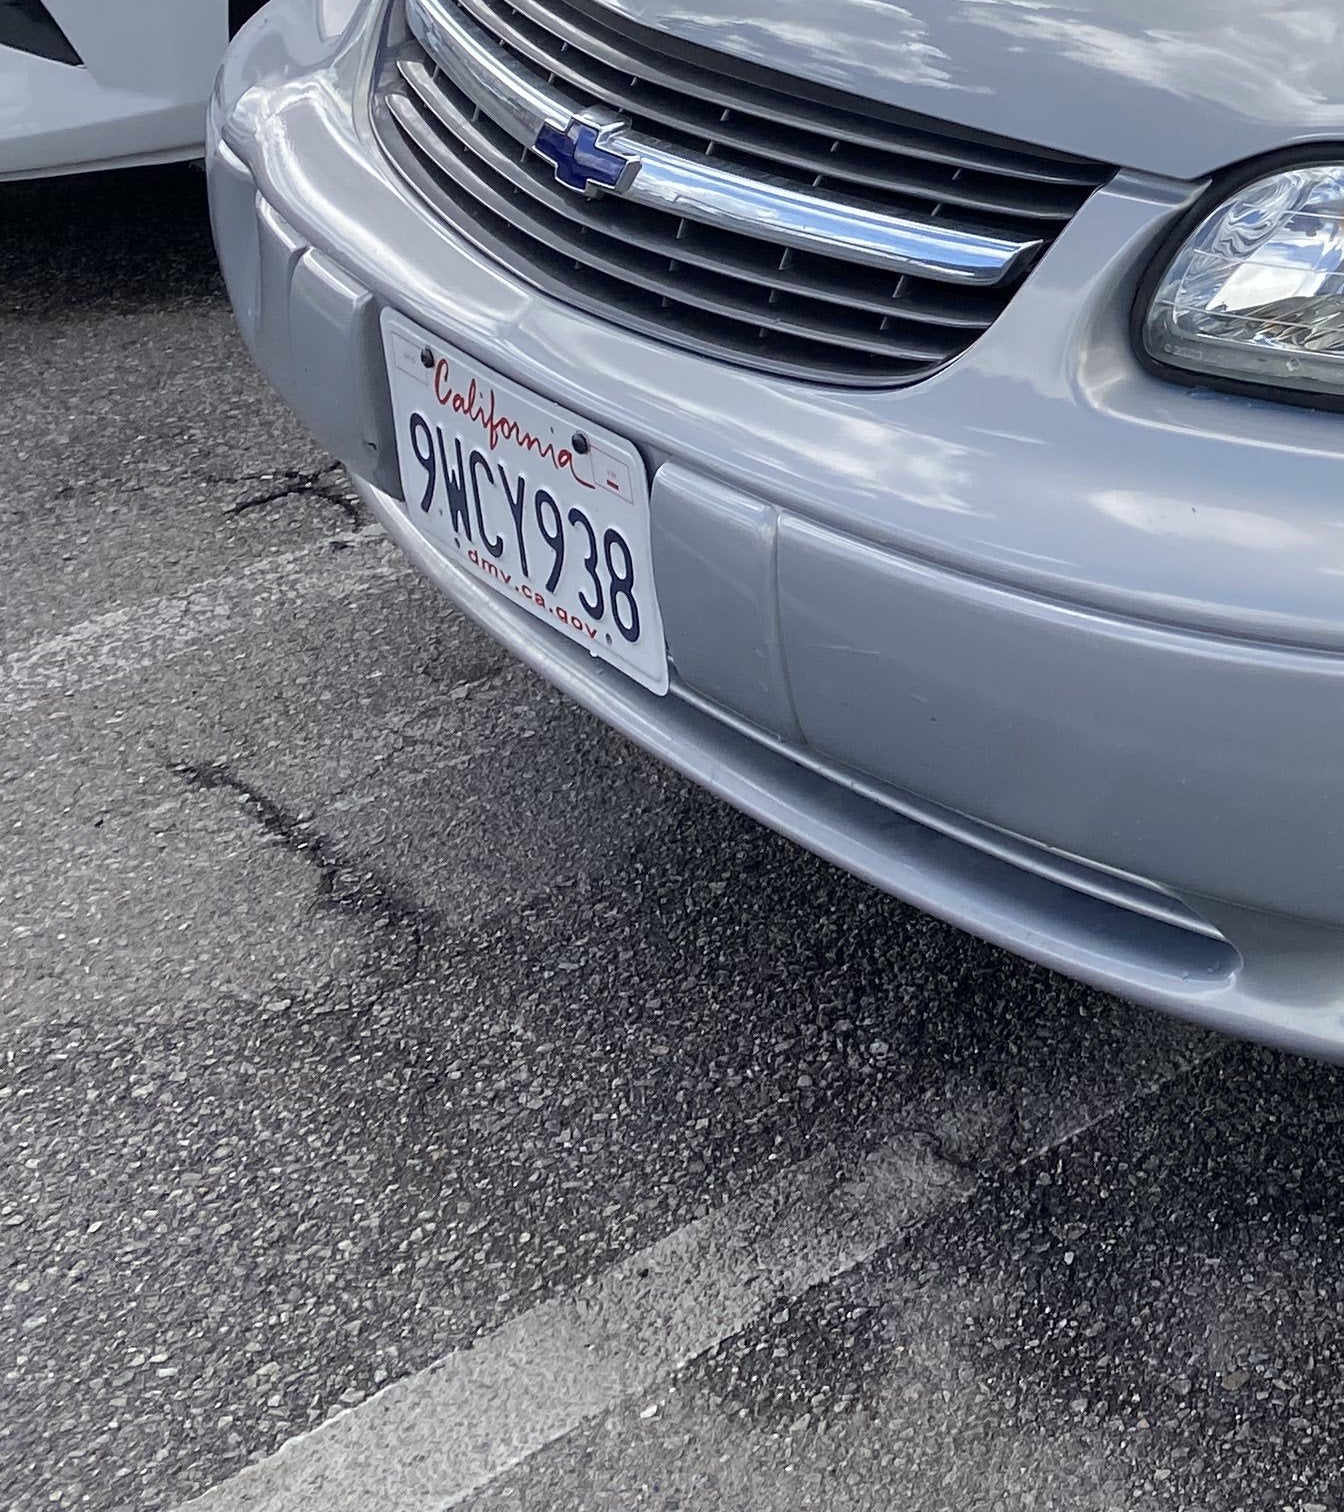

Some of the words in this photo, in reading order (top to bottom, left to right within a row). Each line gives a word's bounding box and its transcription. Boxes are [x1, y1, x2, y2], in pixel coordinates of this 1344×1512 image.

[435, 358, 596, 490] California
[409, 411, 641, 644] 9WCY938
[467, 548, 598, 640] dmv.ca.gov
